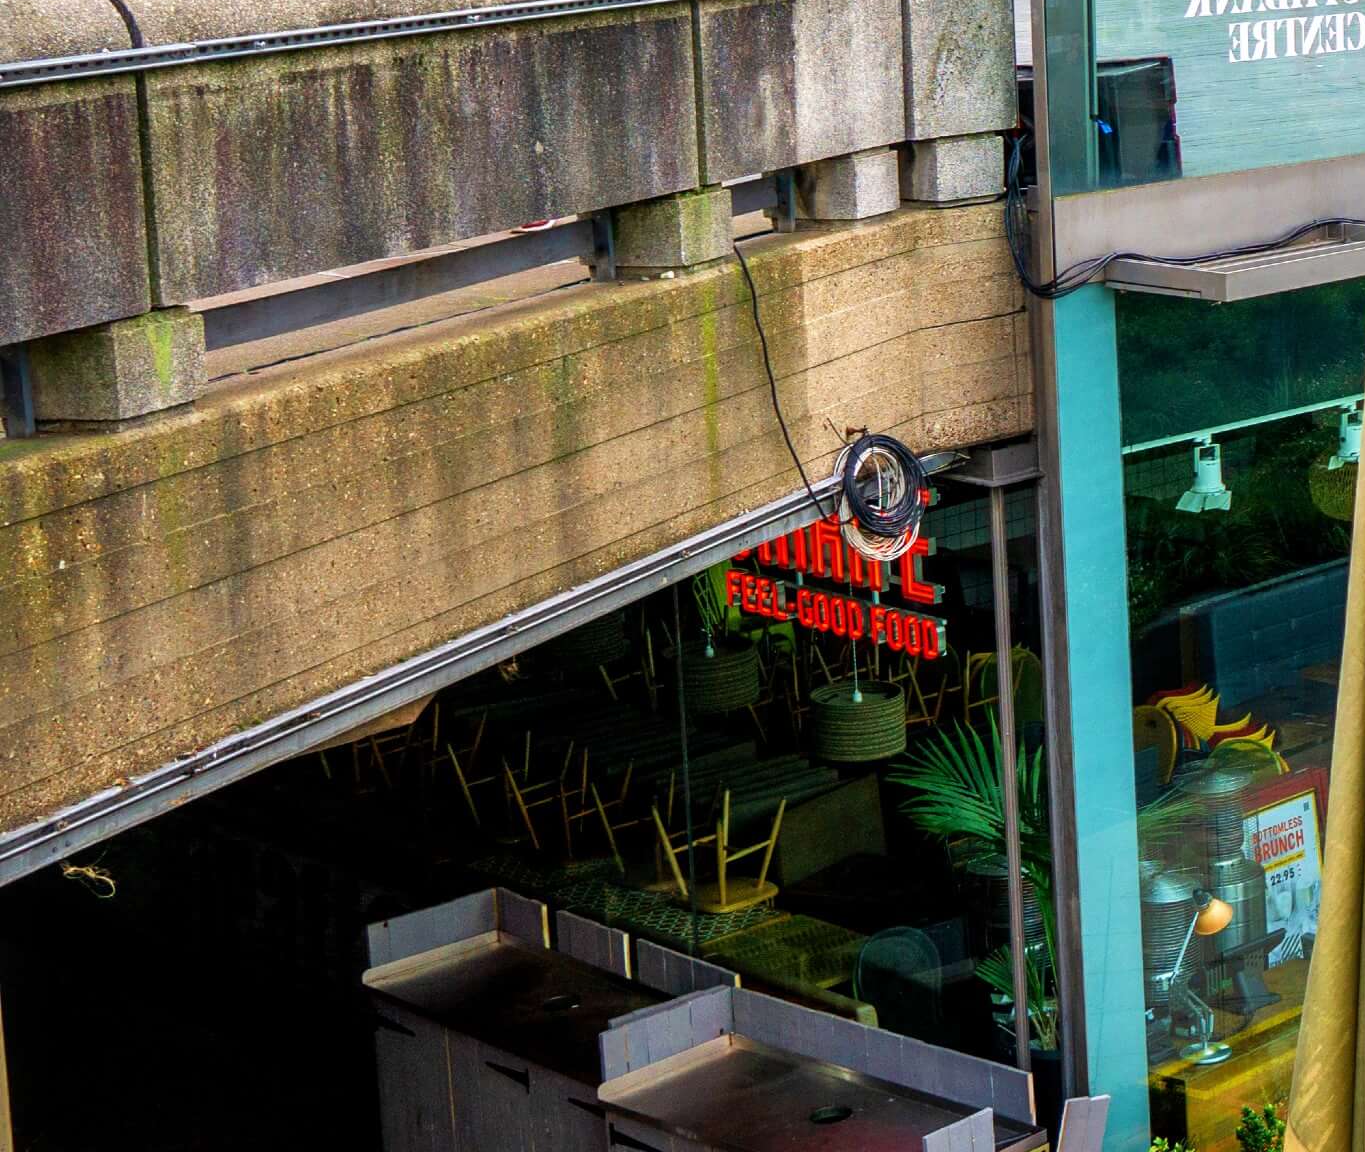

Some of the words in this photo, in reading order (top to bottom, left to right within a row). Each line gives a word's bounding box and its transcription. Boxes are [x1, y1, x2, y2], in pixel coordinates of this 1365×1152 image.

[726, 568, 863, 640] FEEL-GOOD
[870, 604, 940, 660] FOOD
[1252, 815, 1303, 845] BOTTOMLESS
[1254, 830, 1304, 864] BRUNCH
[1270, 867, 1295, 887] 22.95
